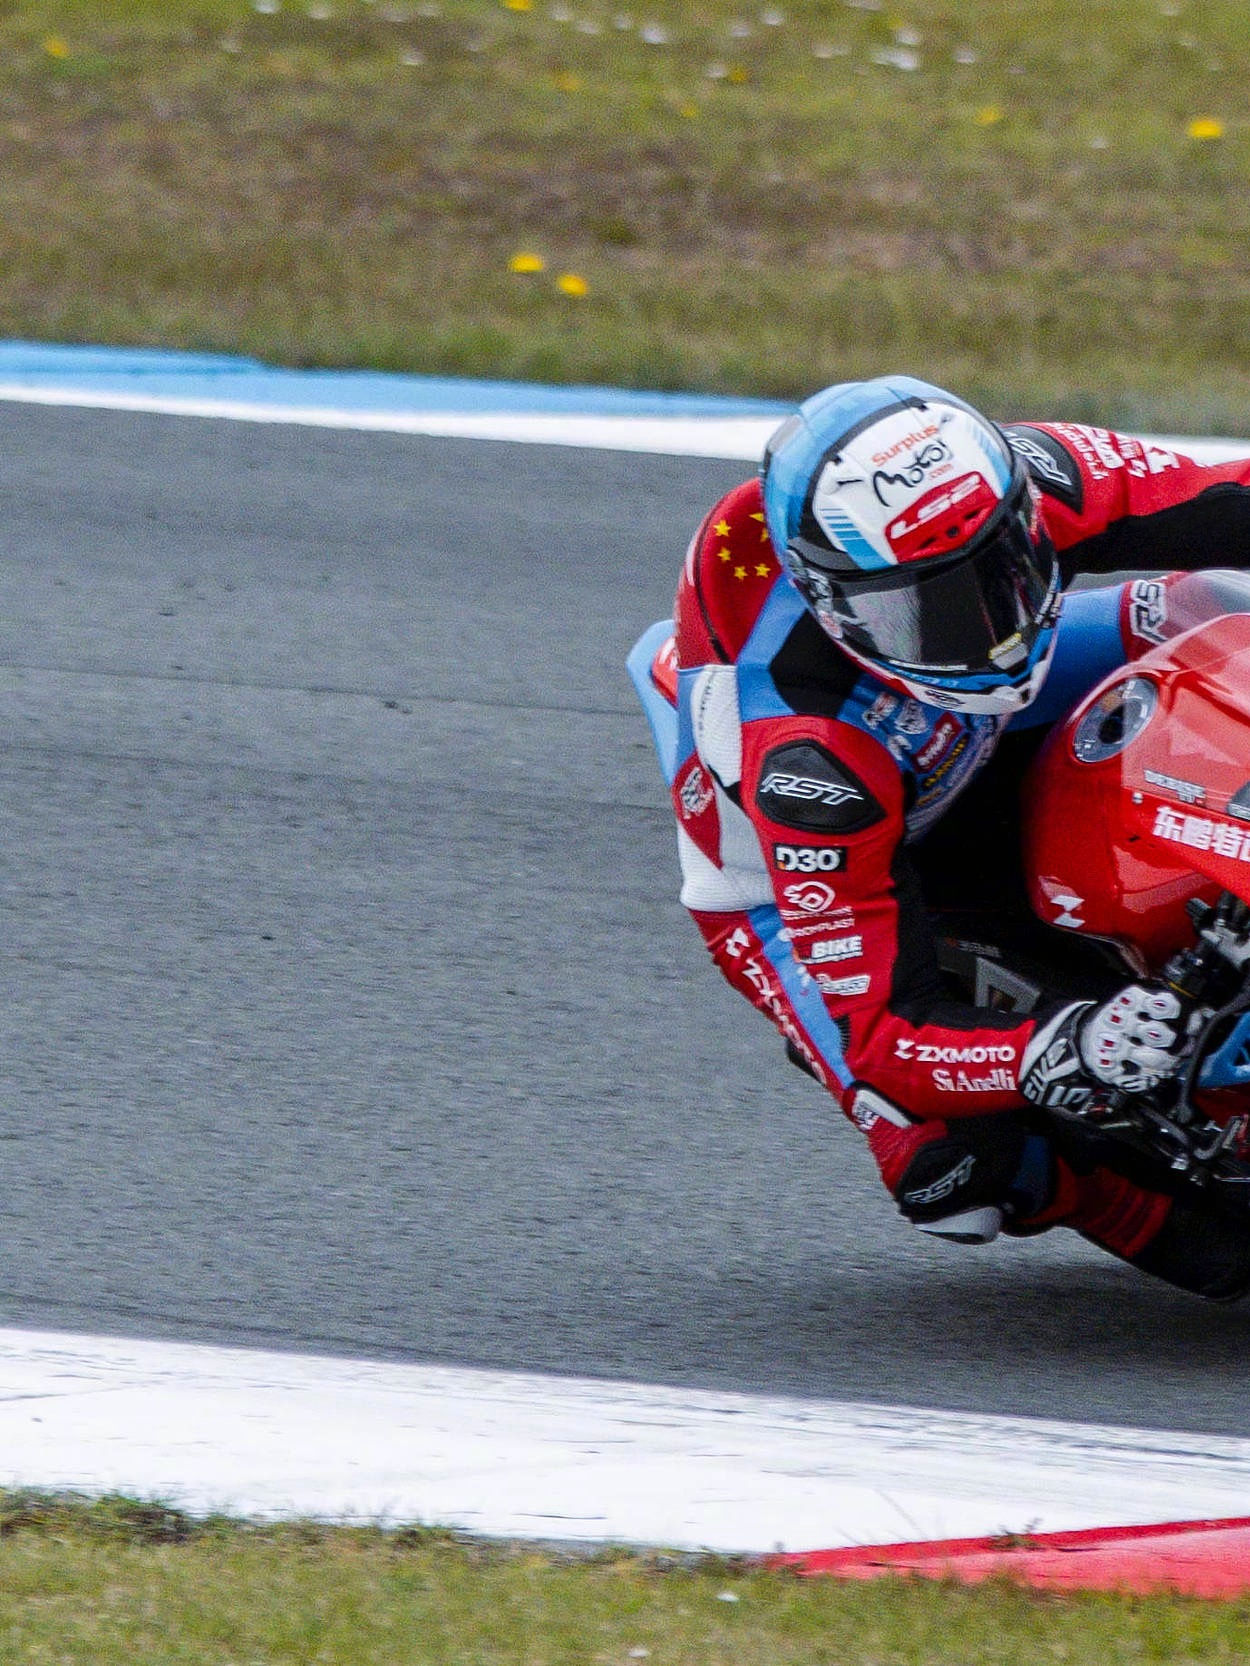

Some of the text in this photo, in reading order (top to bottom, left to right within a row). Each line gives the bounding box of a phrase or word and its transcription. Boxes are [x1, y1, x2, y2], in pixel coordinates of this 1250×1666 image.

[872, 424, 938, 467] Surplus
[1004, 431, 1072, 487] RS
[760, 772, 865, 806] RST
[916, 1046, 1017, 1064] ZXMOTO
